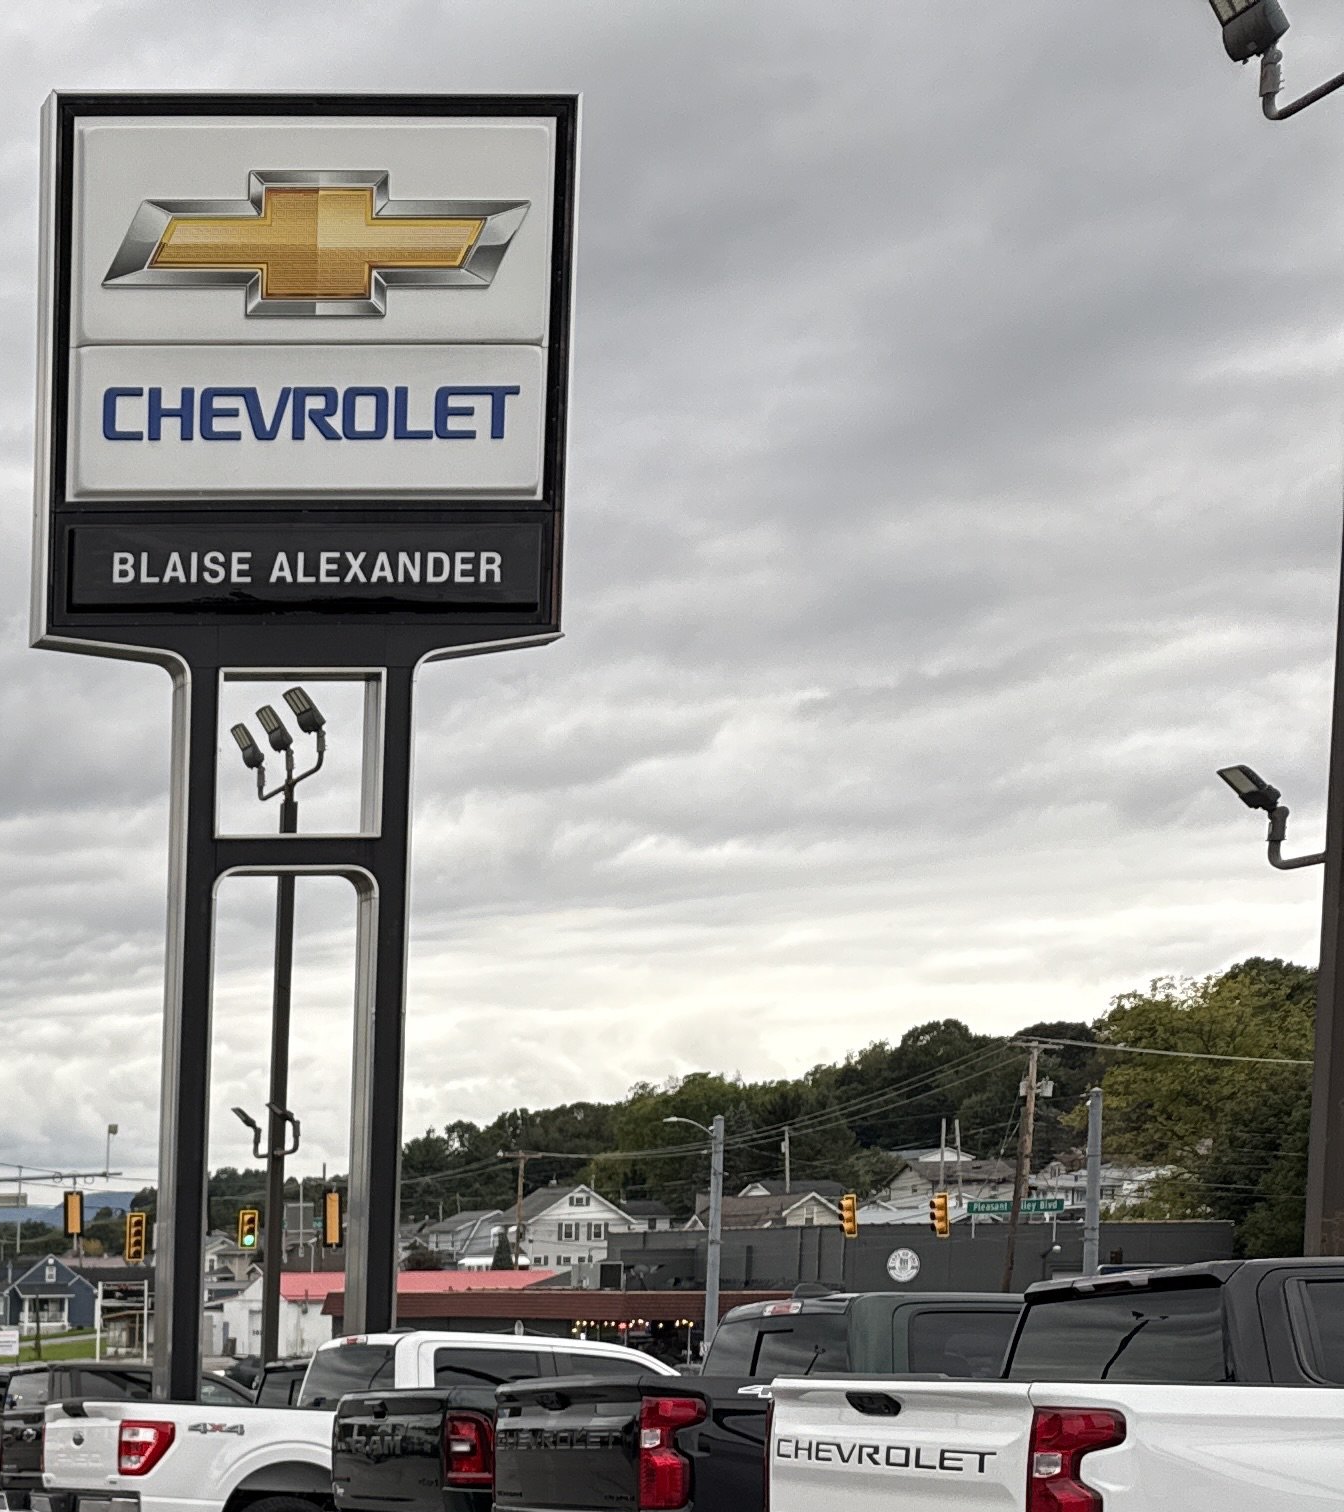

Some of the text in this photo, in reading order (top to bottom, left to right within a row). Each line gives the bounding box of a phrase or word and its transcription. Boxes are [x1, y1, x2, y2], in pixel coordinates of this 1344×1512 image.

[102, 384, 521, 441] CHEVROLET
[112, 550, 503, 585] BLAISE ALEXANDER
[973, 1202, 1008, 1212] Pleasant
[1039, 1200, 1058, 1210] Blvd
[352, 1434, 403, 1455] RAM
[496, 1430, 622, 1450] CHEVROLET
[776, 1438, 997, 1474] CHEVROLET
